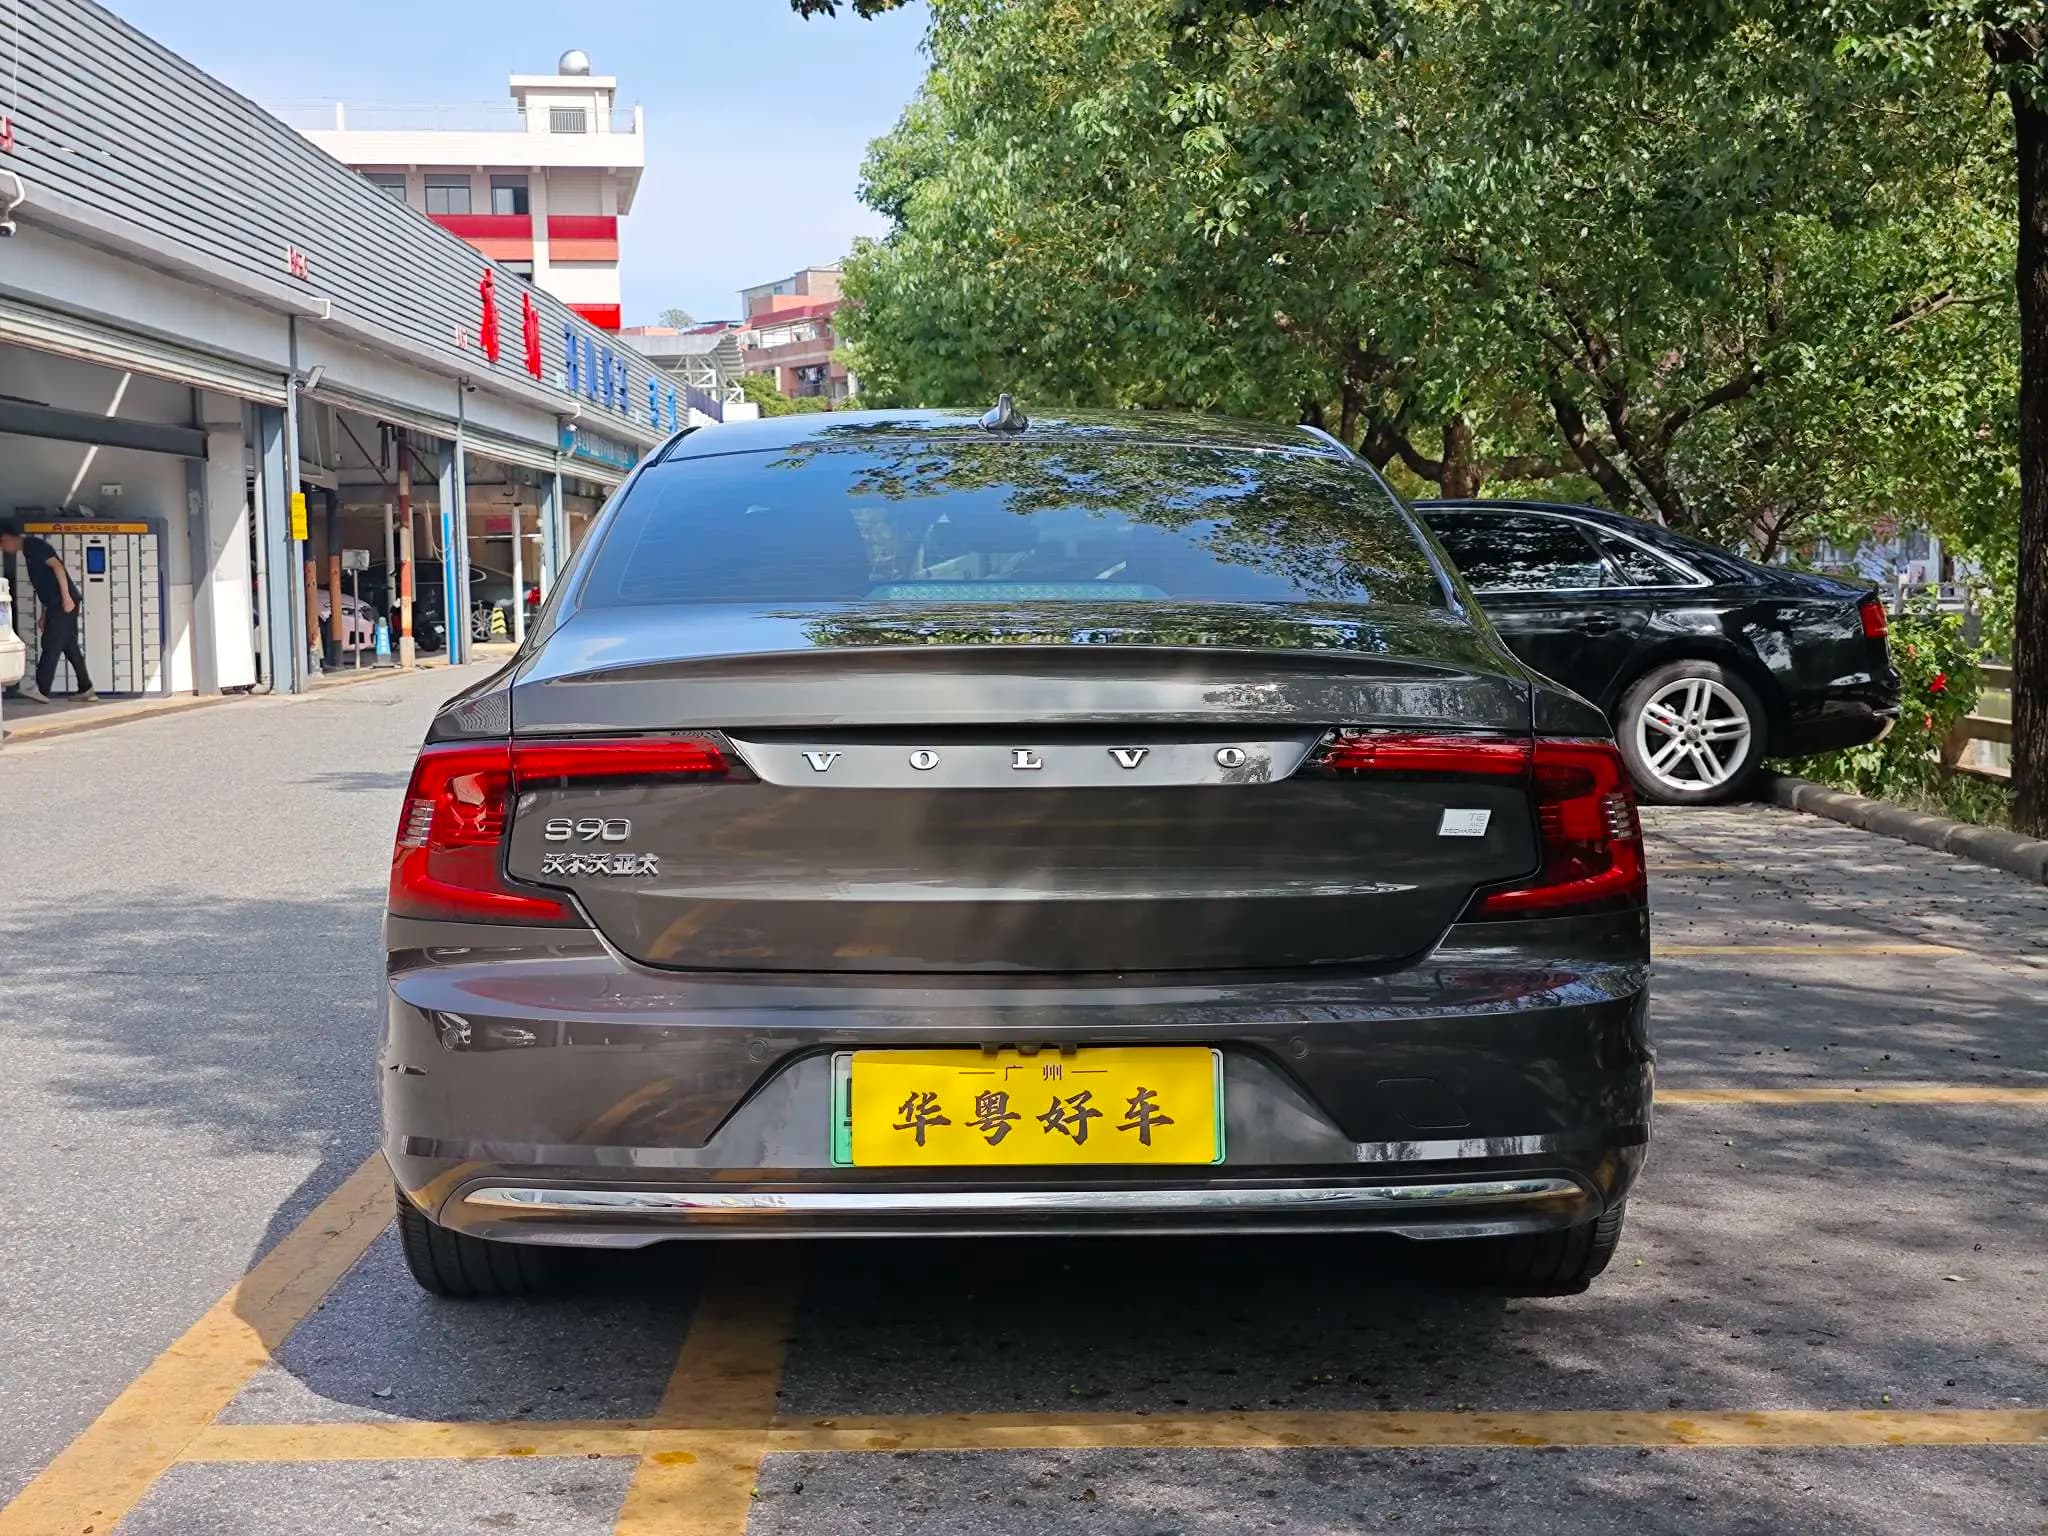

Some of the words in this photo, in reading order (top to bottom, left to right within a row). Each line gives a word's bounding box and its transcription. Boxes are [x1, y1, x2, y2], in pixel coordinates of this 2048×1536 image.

[802, 747, 1247, 771] VOLVO
[544, 818, 632, 841] S90
[541, 852, 660, 875] 沃尔沃亚太
[1005, 1064, 1063, 1081] 广州
[893, 1086, 1175, 1148] 华粤好车
